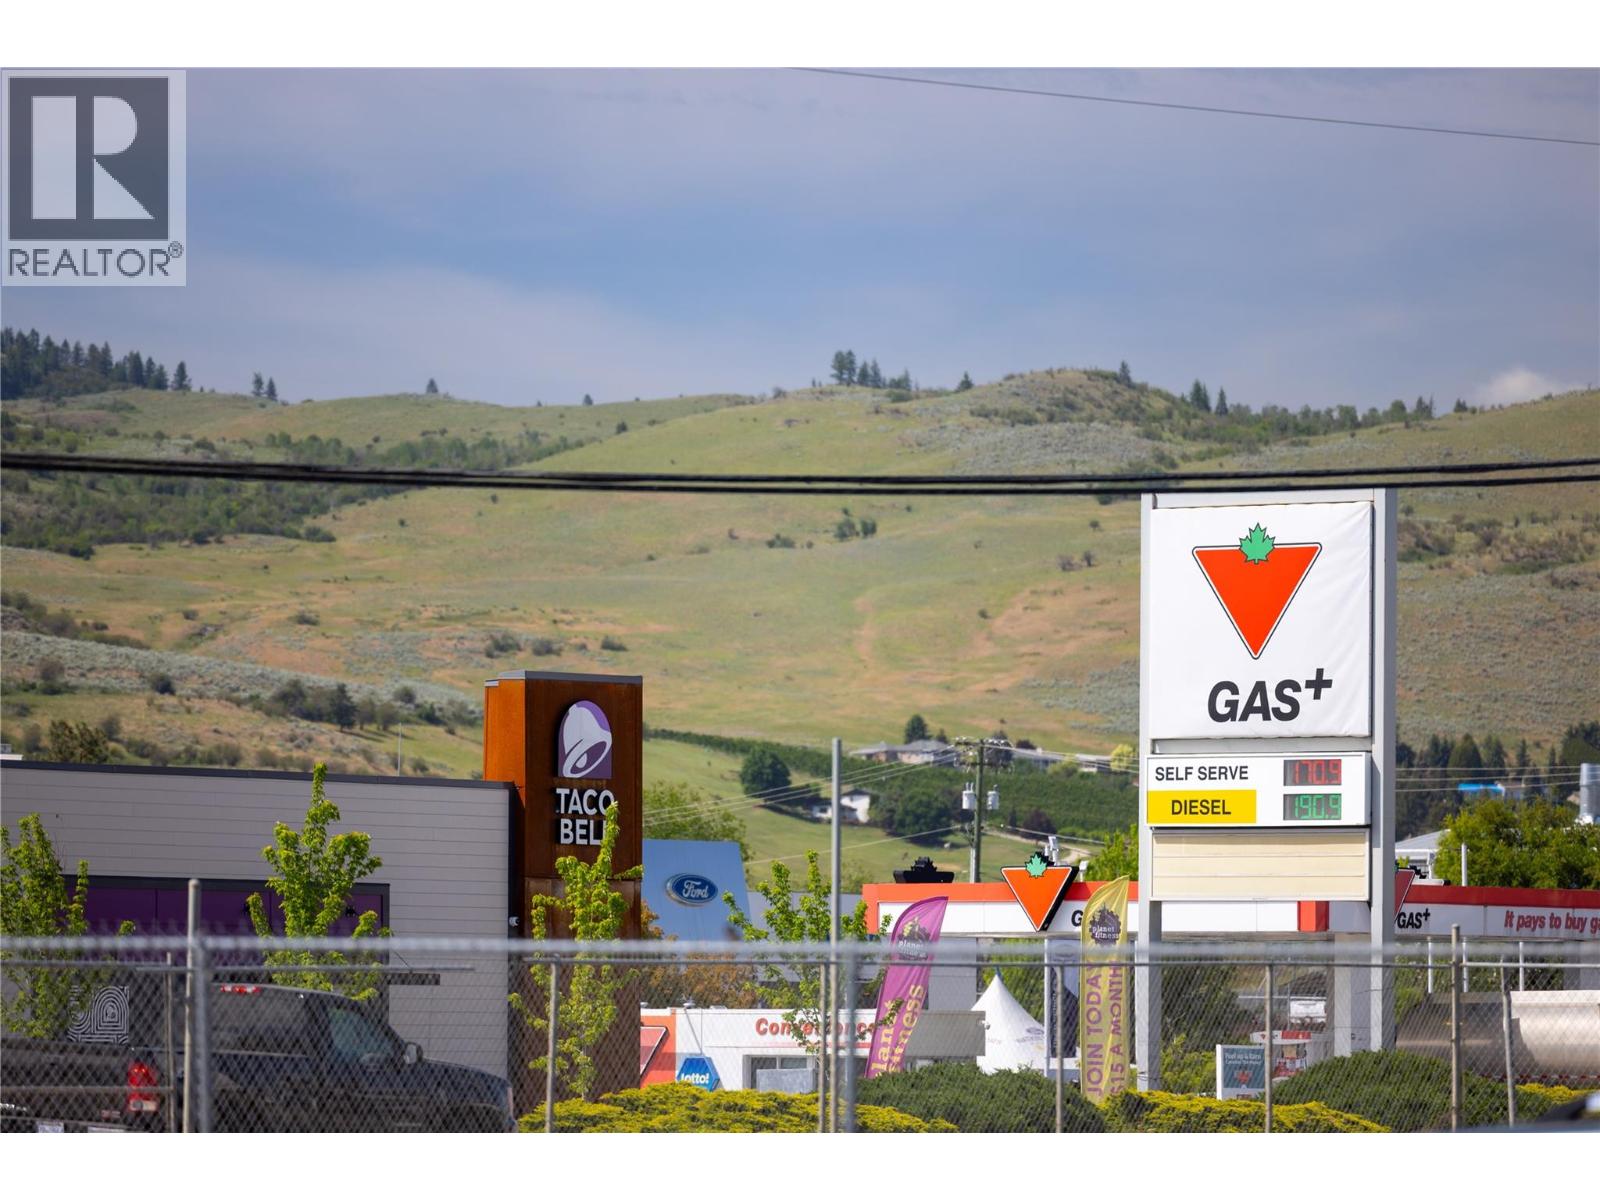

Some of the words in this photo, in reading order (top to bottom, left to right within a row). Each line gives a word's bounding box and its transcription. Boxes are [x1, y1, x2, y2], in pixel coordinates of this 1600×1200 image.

[1155, 766, 1194, 782] SELF
[1197, 765, 1249, 781] SERVE
[555, 787, 615, 816] TACO
[1171, 799, 1232, 816] DIESEL
[682, 879, 709, 898] Ford
[1504, 910, 1515, 929] It
[1516, 914, 1547, 932] pays
[1549, 912, 1562, 929] to
[1565, 912, 1588, 933] buy
[1111, 1043, 1123, 1056] A
[1086, 1042, 1103, 1096] JOIN
